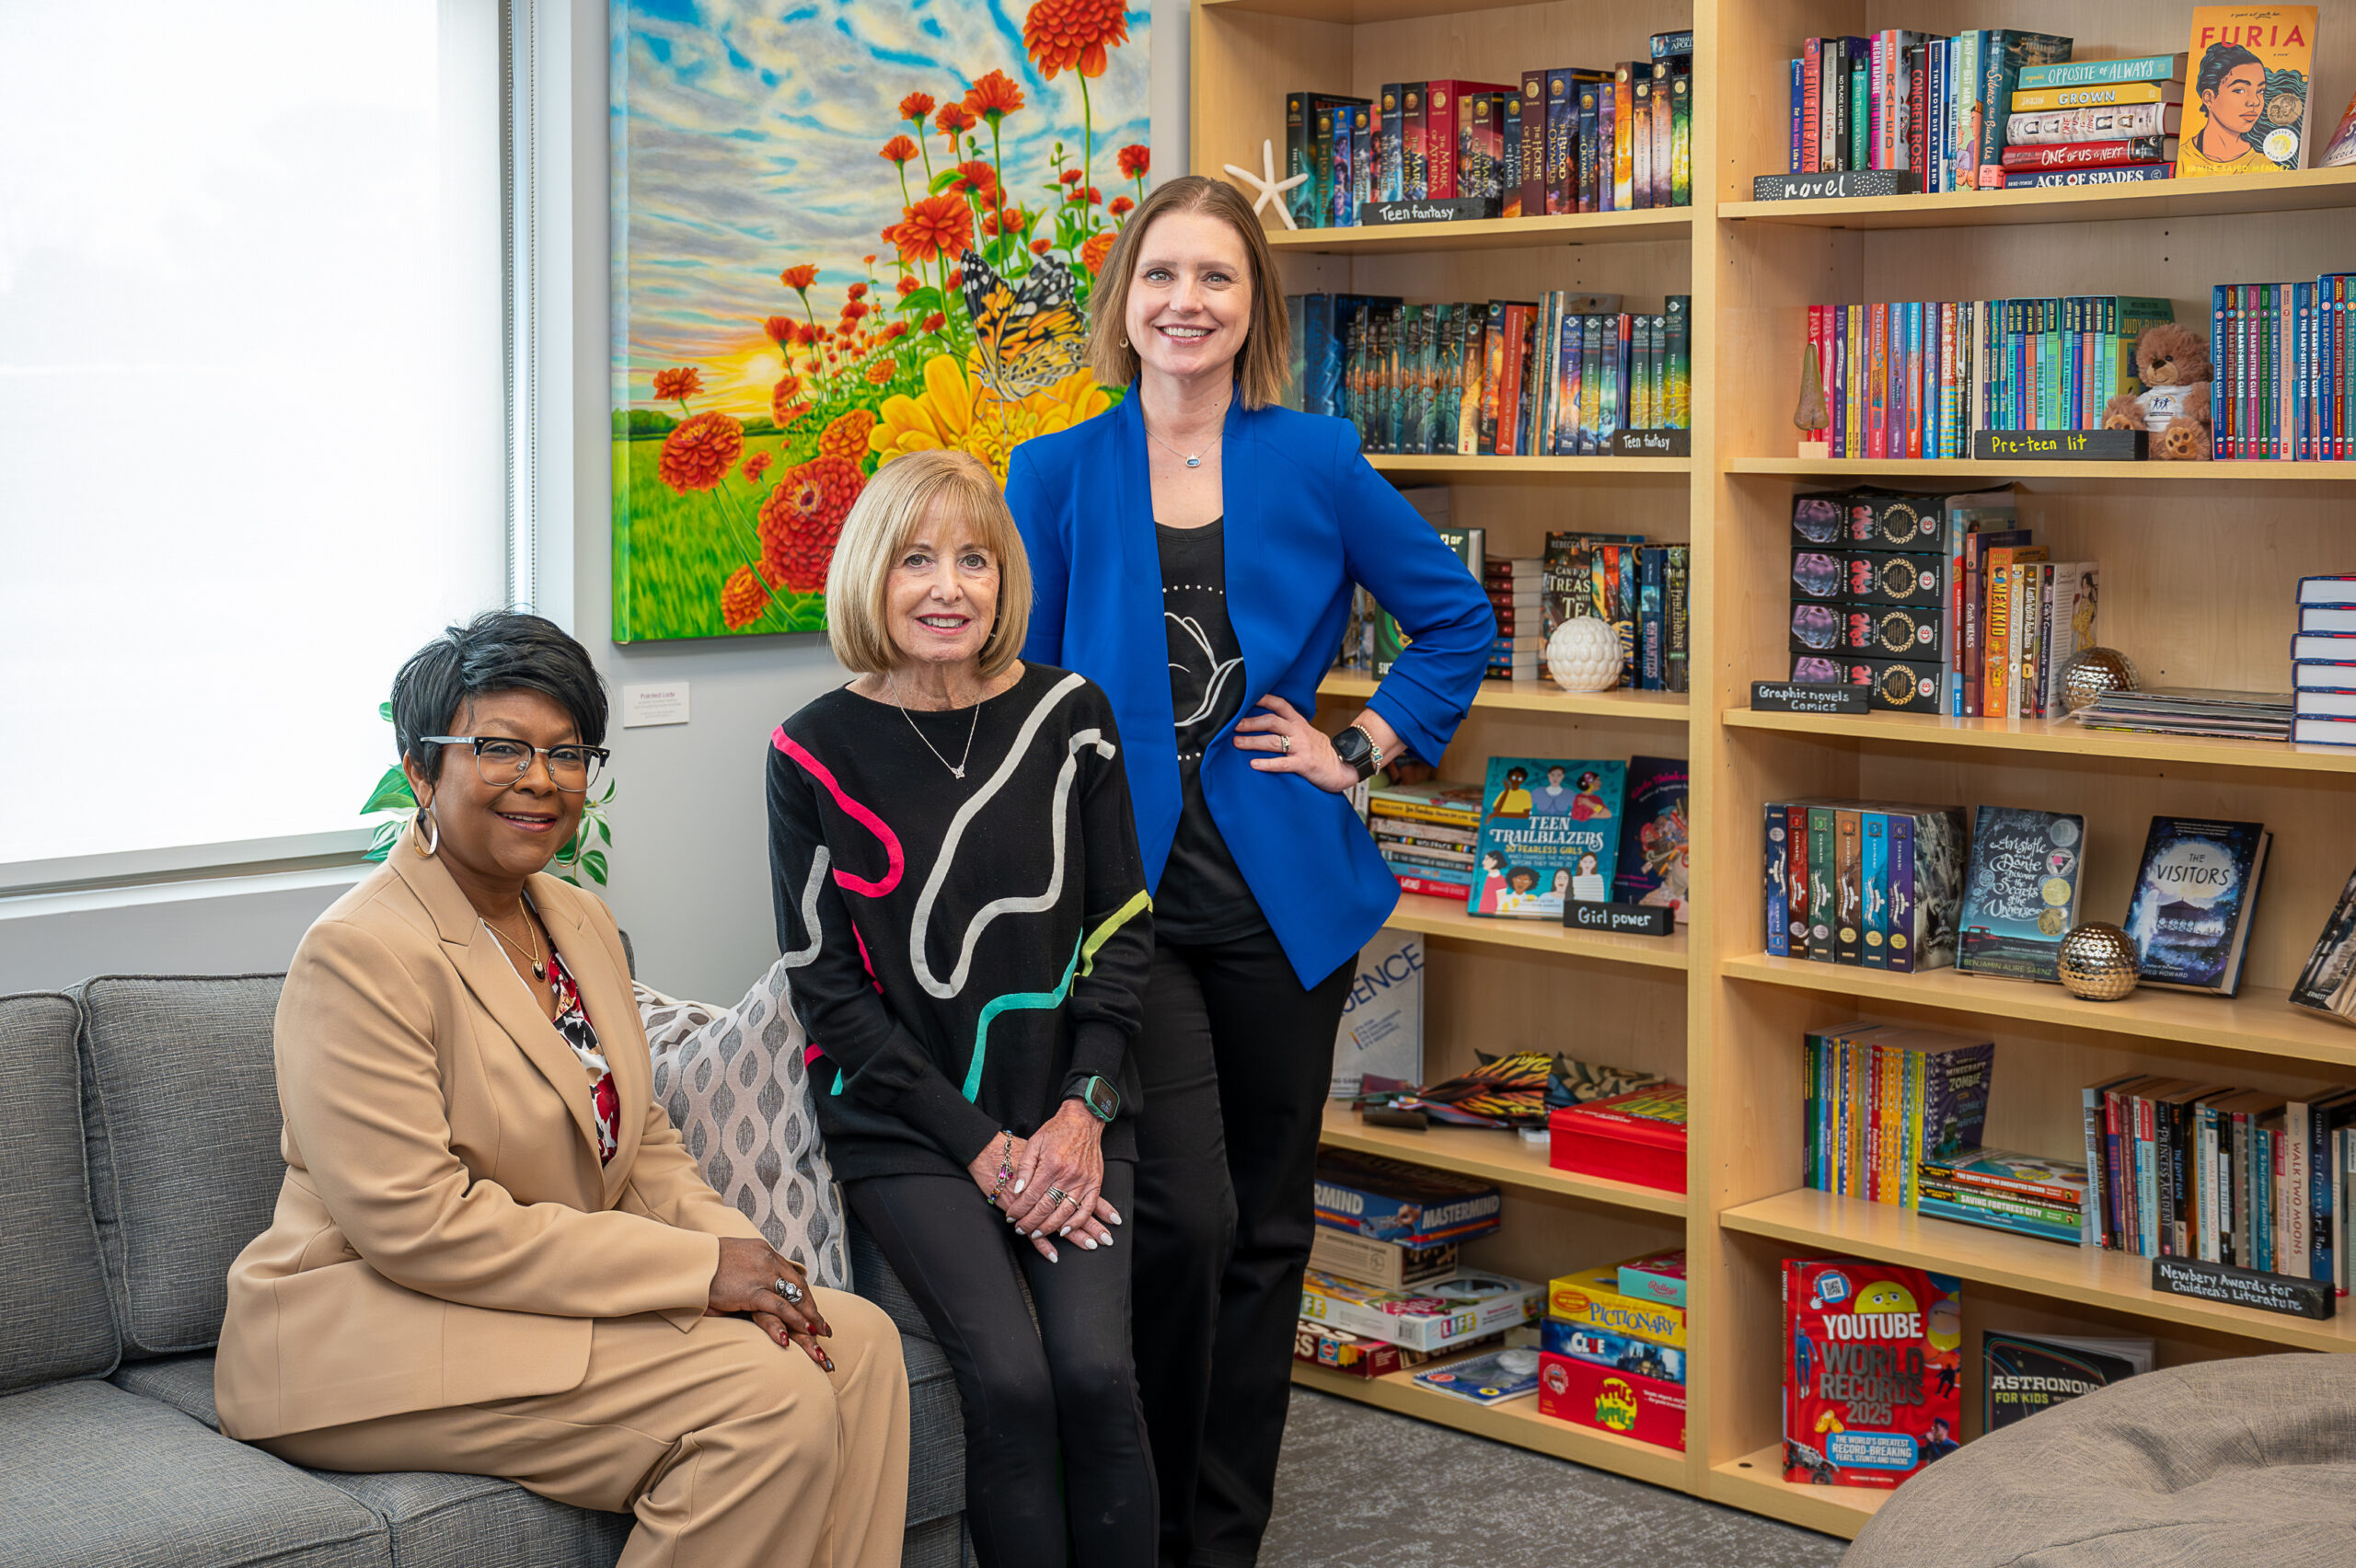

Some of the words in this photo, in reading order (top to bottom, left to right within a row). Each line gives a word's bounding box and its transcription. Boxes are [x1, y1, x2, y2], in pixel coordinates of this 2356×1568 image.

[1964, 40, 1973, 54] MAY
[2200, 25, 2304, 49] FURIA
[1873, 40, 1881, 64] MEGAN
[1839, 75, 1843, 85] NO
[1963, 69, 1972, 85] BEST
[2049, 65, 2095, 84] OPPOSITE
[2108, 61, 2154, 79] ALWAYS
[1804, 76, 1816, 103] FIVE
[1963, 86, 1971, 105] MAN
[1986, 71, 2002, 105] Silence
[2059, 91, 2116, 105] GROWN
[1886, 74, 1894, 149] RATED
[1911, 69, 1923, 131] CONCRETE
[1804, 107, 1816, 133] FEET
[1962, 110, 1970, 127] WIN
[1933, 136, 1937, 145] AT
[1984, 120, 1996, 146] Binds
[1522, 138, 1531, 180] HADES
[1532, 140, 1542, 181] HOUSE
[1548, 128, 1557, 184] OLYMPUS
[1558, 136, 1568, 179] BLOOD
[1911, 135, 1923, 174] ROSE
[1984, 147, 1994, 160] Us
[2041, 147, 2068, 166] ONE
[2068, 152, 2079, 162] OF
[2080, 149, 2091, 161] US
[2100, 147, 2123, 161] NEXT
[1429, 144, 1438, 192] ATHENA
[1439, 150, 1449, 190] MARK
[2036, 174, 2064, 188] ACE
[2067, 172, 2085, 186] OF
[2088, 170, 2144, 184] SPADES
[1784, 177, 1845, 200] novel
[1380, 204, 1410, 221] Teen
[1412, 204, 1454, 222] fantasy
[2122, 318, 2142, 334] JUDY
[1623, 434, 1641, 449] Teen
[1644, 433, 1669, 451] fantasy
[1992, 436, 2057, 453] Pre-teen
[2068, 434, 2087, 450] lit
[1670, 589, 1683, 650] FABLEHAVEN
[1992, 583, 2007, 637] MEXIKID
[1759, 686, 1807, 702] Graphic
[1809, 690, 1849, 702] novels
[1791, 701, 1837, 712] Comics
[1529, 816, 1571, 830] TEEN
[1489, 829, 1603, 852] TRAILBLAZERS
[1519, 845, 1557, 854] FEARLESS
[1990, 835, 2049, 854] Aristotle
[1990, 853, 2042, 872] Dante
[2189, 853, 2206, 862] THE
[2157, 864, 2230, 886] VISITORS
[1577, 907, 1608, 925] Girl
[1611, 915, 1652, 928] power
[1964, 959, 2001, 969] BENJAMIN
[1949, 1072, 1981, 1092] ZOMBIE
[2160, 1127, 2169, 1179] PRINCESS
[2292, 1142, 2301, 1176] WALK
[2292, 1179, 2301, 1205] TWO
[1423, 1195, 1500, 1229] MASTERMIND
[1960, 1194, 1987, 1206] SAVING
[1988, 1200, 2024, 1214] FORTRESS
[2026, 1207, 2042, 1217] CITY
[2292, 1209, 2303, 1255] MOONS
[2160, 1264, 2216, 1287] Newbery
[2220, 1274, 2267, 1294] Awards
[2269, 1284, 2292, 1297] for
[2172, 1281, 2228, 1298] Children's
[2233, 1289, 2303, 1310] Literature
[1441, 1314, 1475, 1338] LIFE
[1588, 1302, 1680, 1335] PICTIONARY
[1822, 1313, 1923, 1340] YOUTUBE
[1571, 1332, 1605, 1354] CLUE
[1820, 1342, 1924, 1378] WORLD
[1819, 1372, 1924, 1405] RECORDS
[1992, 1376, 2103, 1395] ASTRONOM
[1995, 1392, 2018, 1403] FOR
[2021, 1392, 2049, 1404] KIDS
[1846, 1401, 1892, 1425] 2025
[1832, 1443, 1912, 1458] RECORD-BREAKING
[1836, 1435, 1847, 1444] THE
[1849, 1435, 1877, 1446] WORLD'S
[1878, 1437, 1909, 1447] GREATEST
